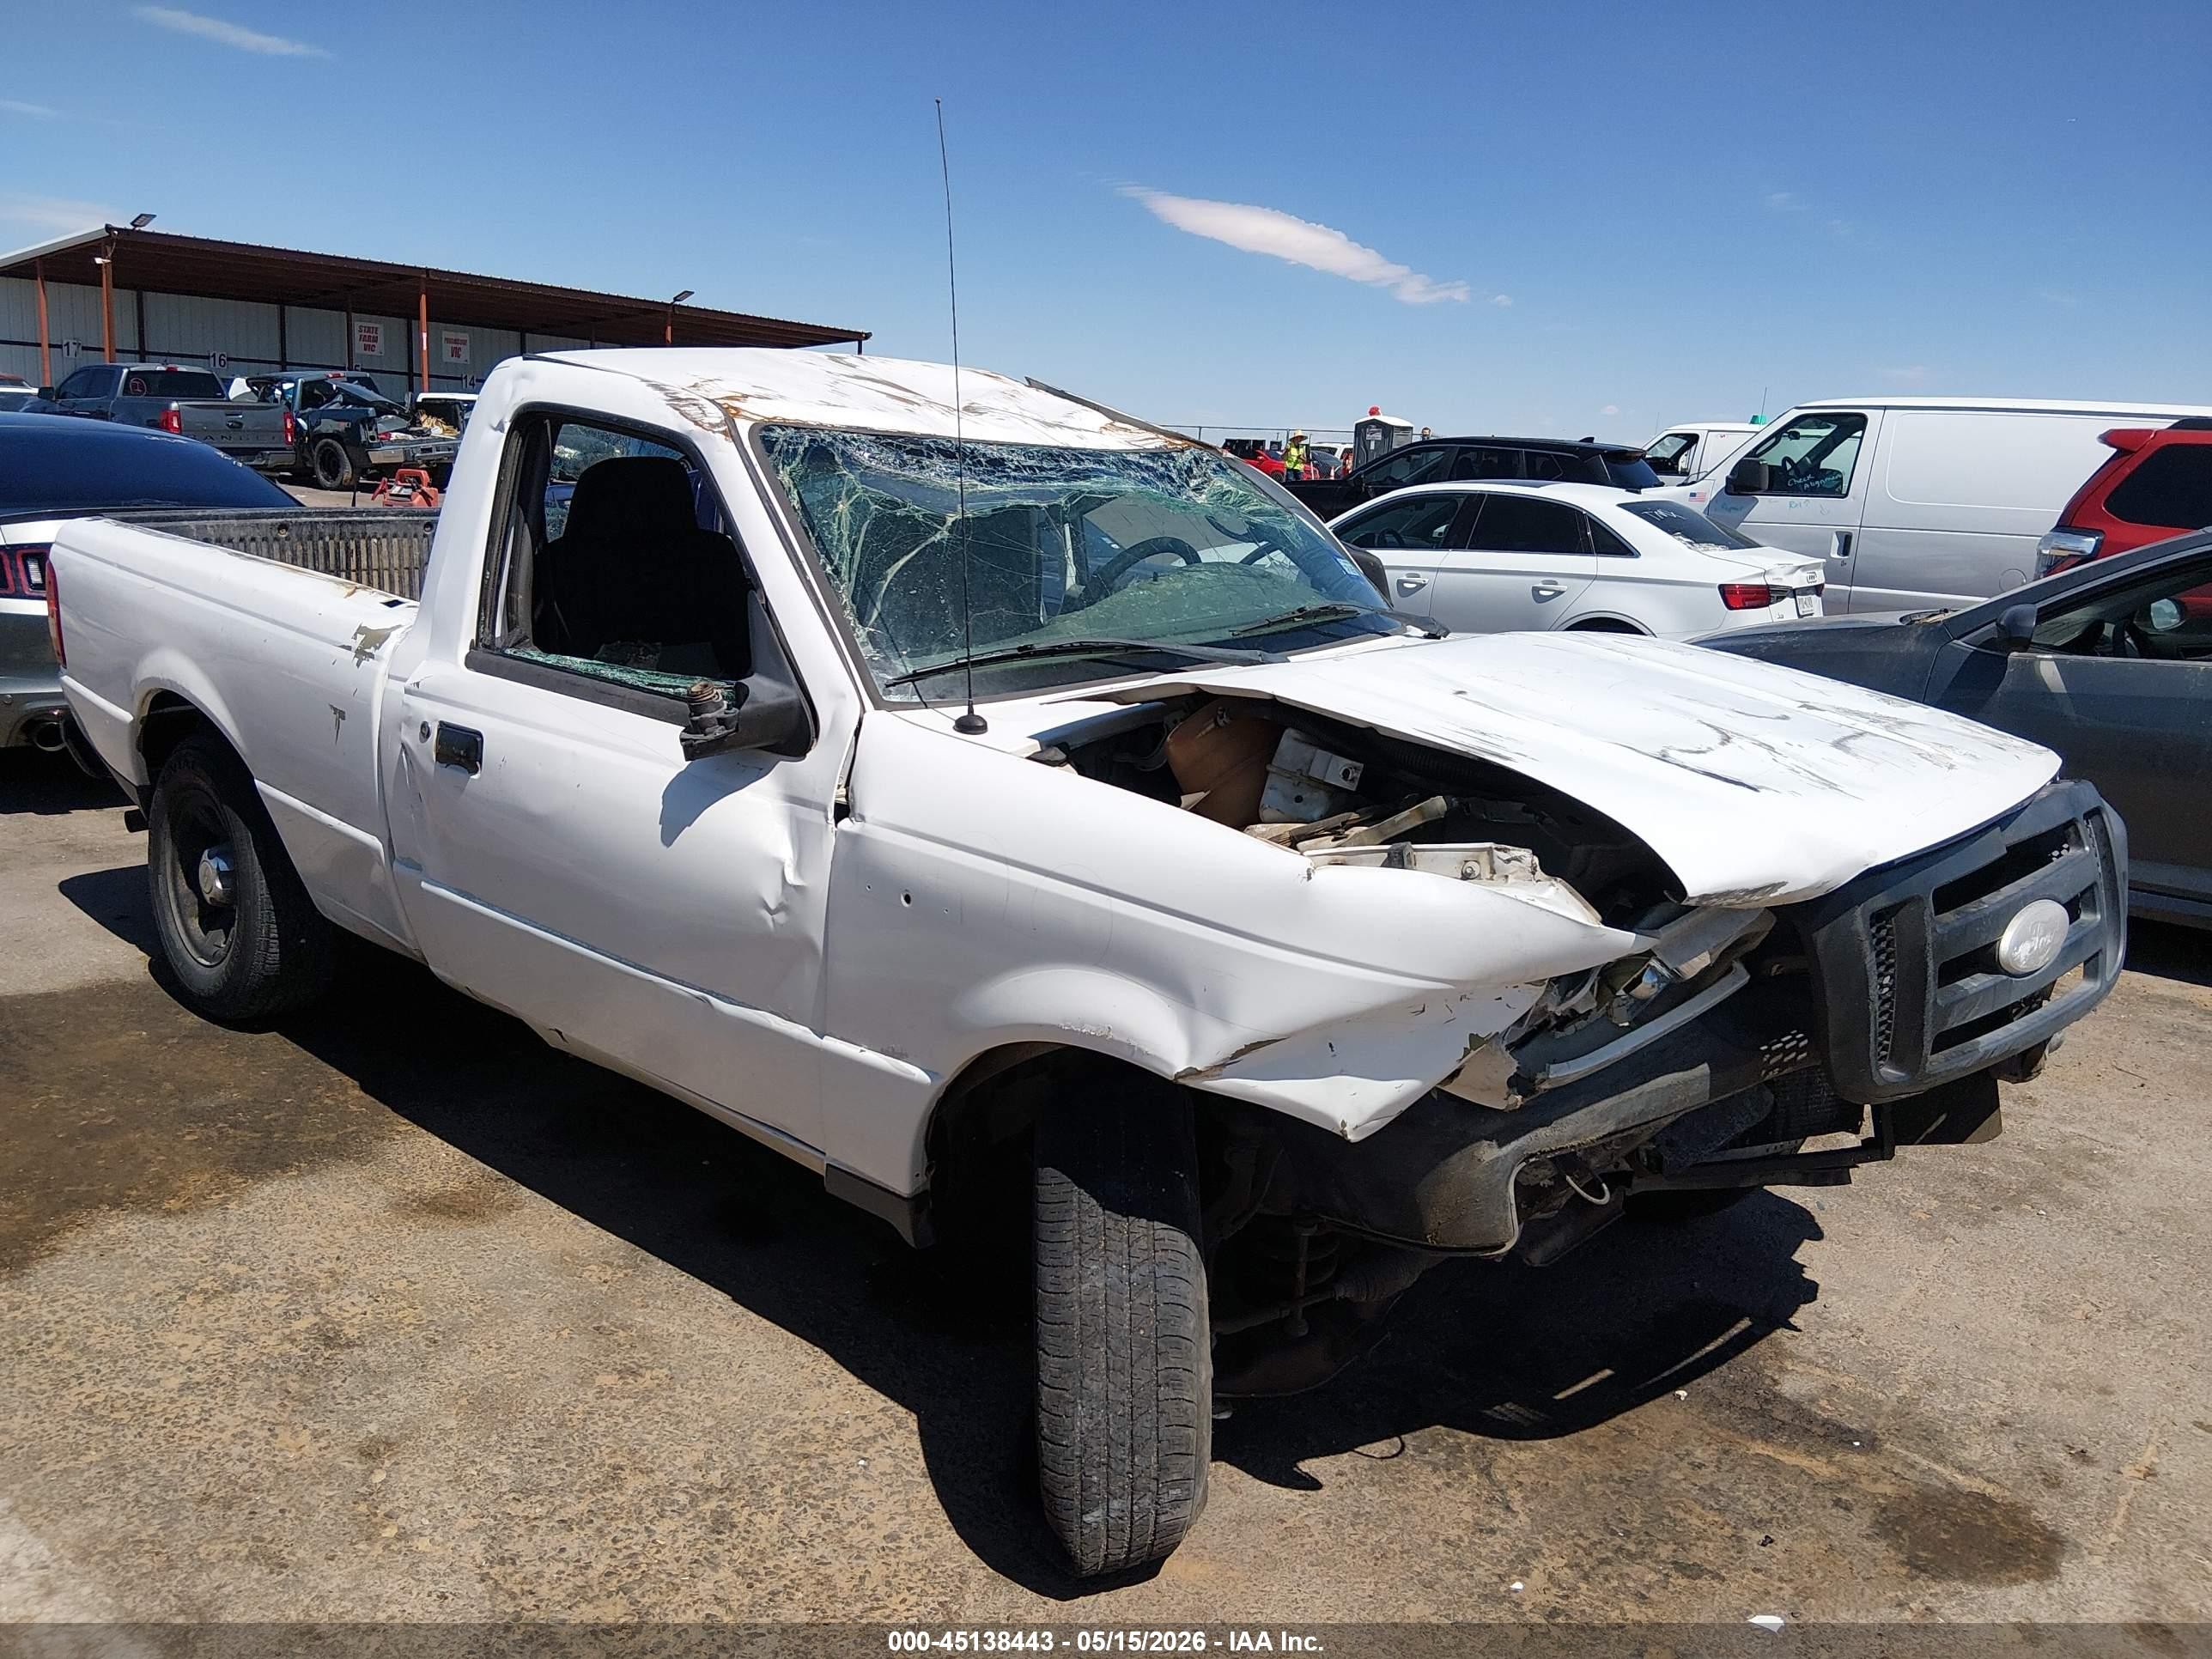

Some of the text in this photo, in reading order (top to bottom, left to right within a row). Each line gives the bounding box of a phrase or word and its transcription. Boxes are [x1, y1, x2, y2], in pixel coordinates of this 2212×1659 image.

[358, 325, 379, 334] STATE
[359, 334, 379, 343] FARM
[64, 342, 82, 358] 17
[364, 343, 376, 352] VIC
[451, 346, 462, 358] VIC
[210, 353, 227, 368] 16
[464, 374, 475, 389] 14
[1787, 473, 1815, 487] Check
